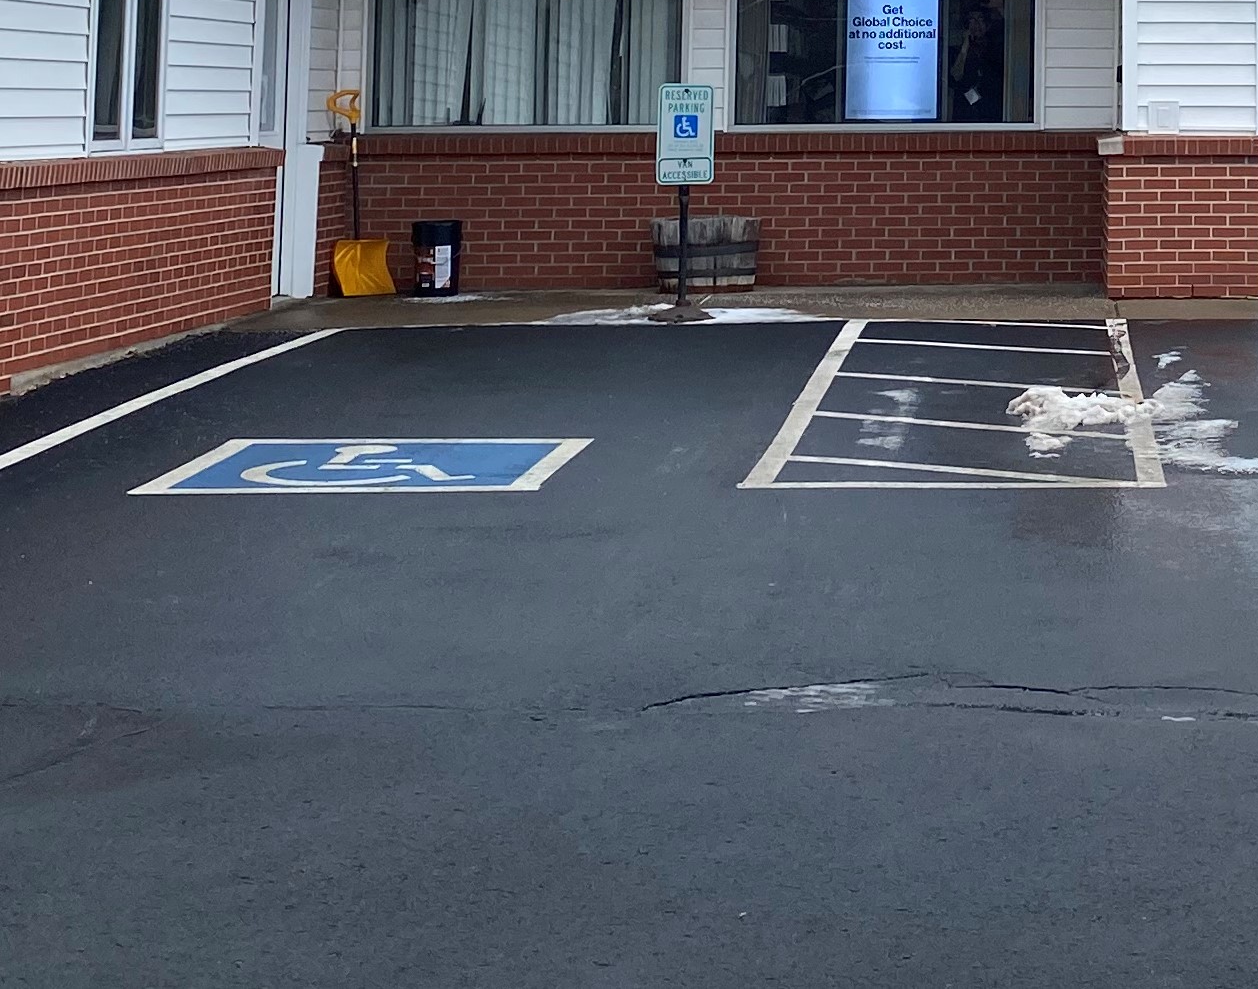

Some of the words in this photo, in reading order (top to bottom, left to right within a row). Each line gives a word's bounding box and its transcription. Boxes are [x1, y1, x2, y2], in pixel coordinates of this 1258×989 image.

[882, 4, 904, 15] Get
[852, 16, 890, 27] Global
[892, 16, 933, 27] Choice
[849, 29, 860, 39] at
[862, 30, 877, 39] no
[878, 28, 936, 39] additional
[878, 40, 906, 50] cost.
[665, 90, 709, 101] RESERVED
[668, 103, 705, 113] PARKING
[677, 160, 693, 169] VAN
[662, 170, 708, 180] ACCESSIBLE
